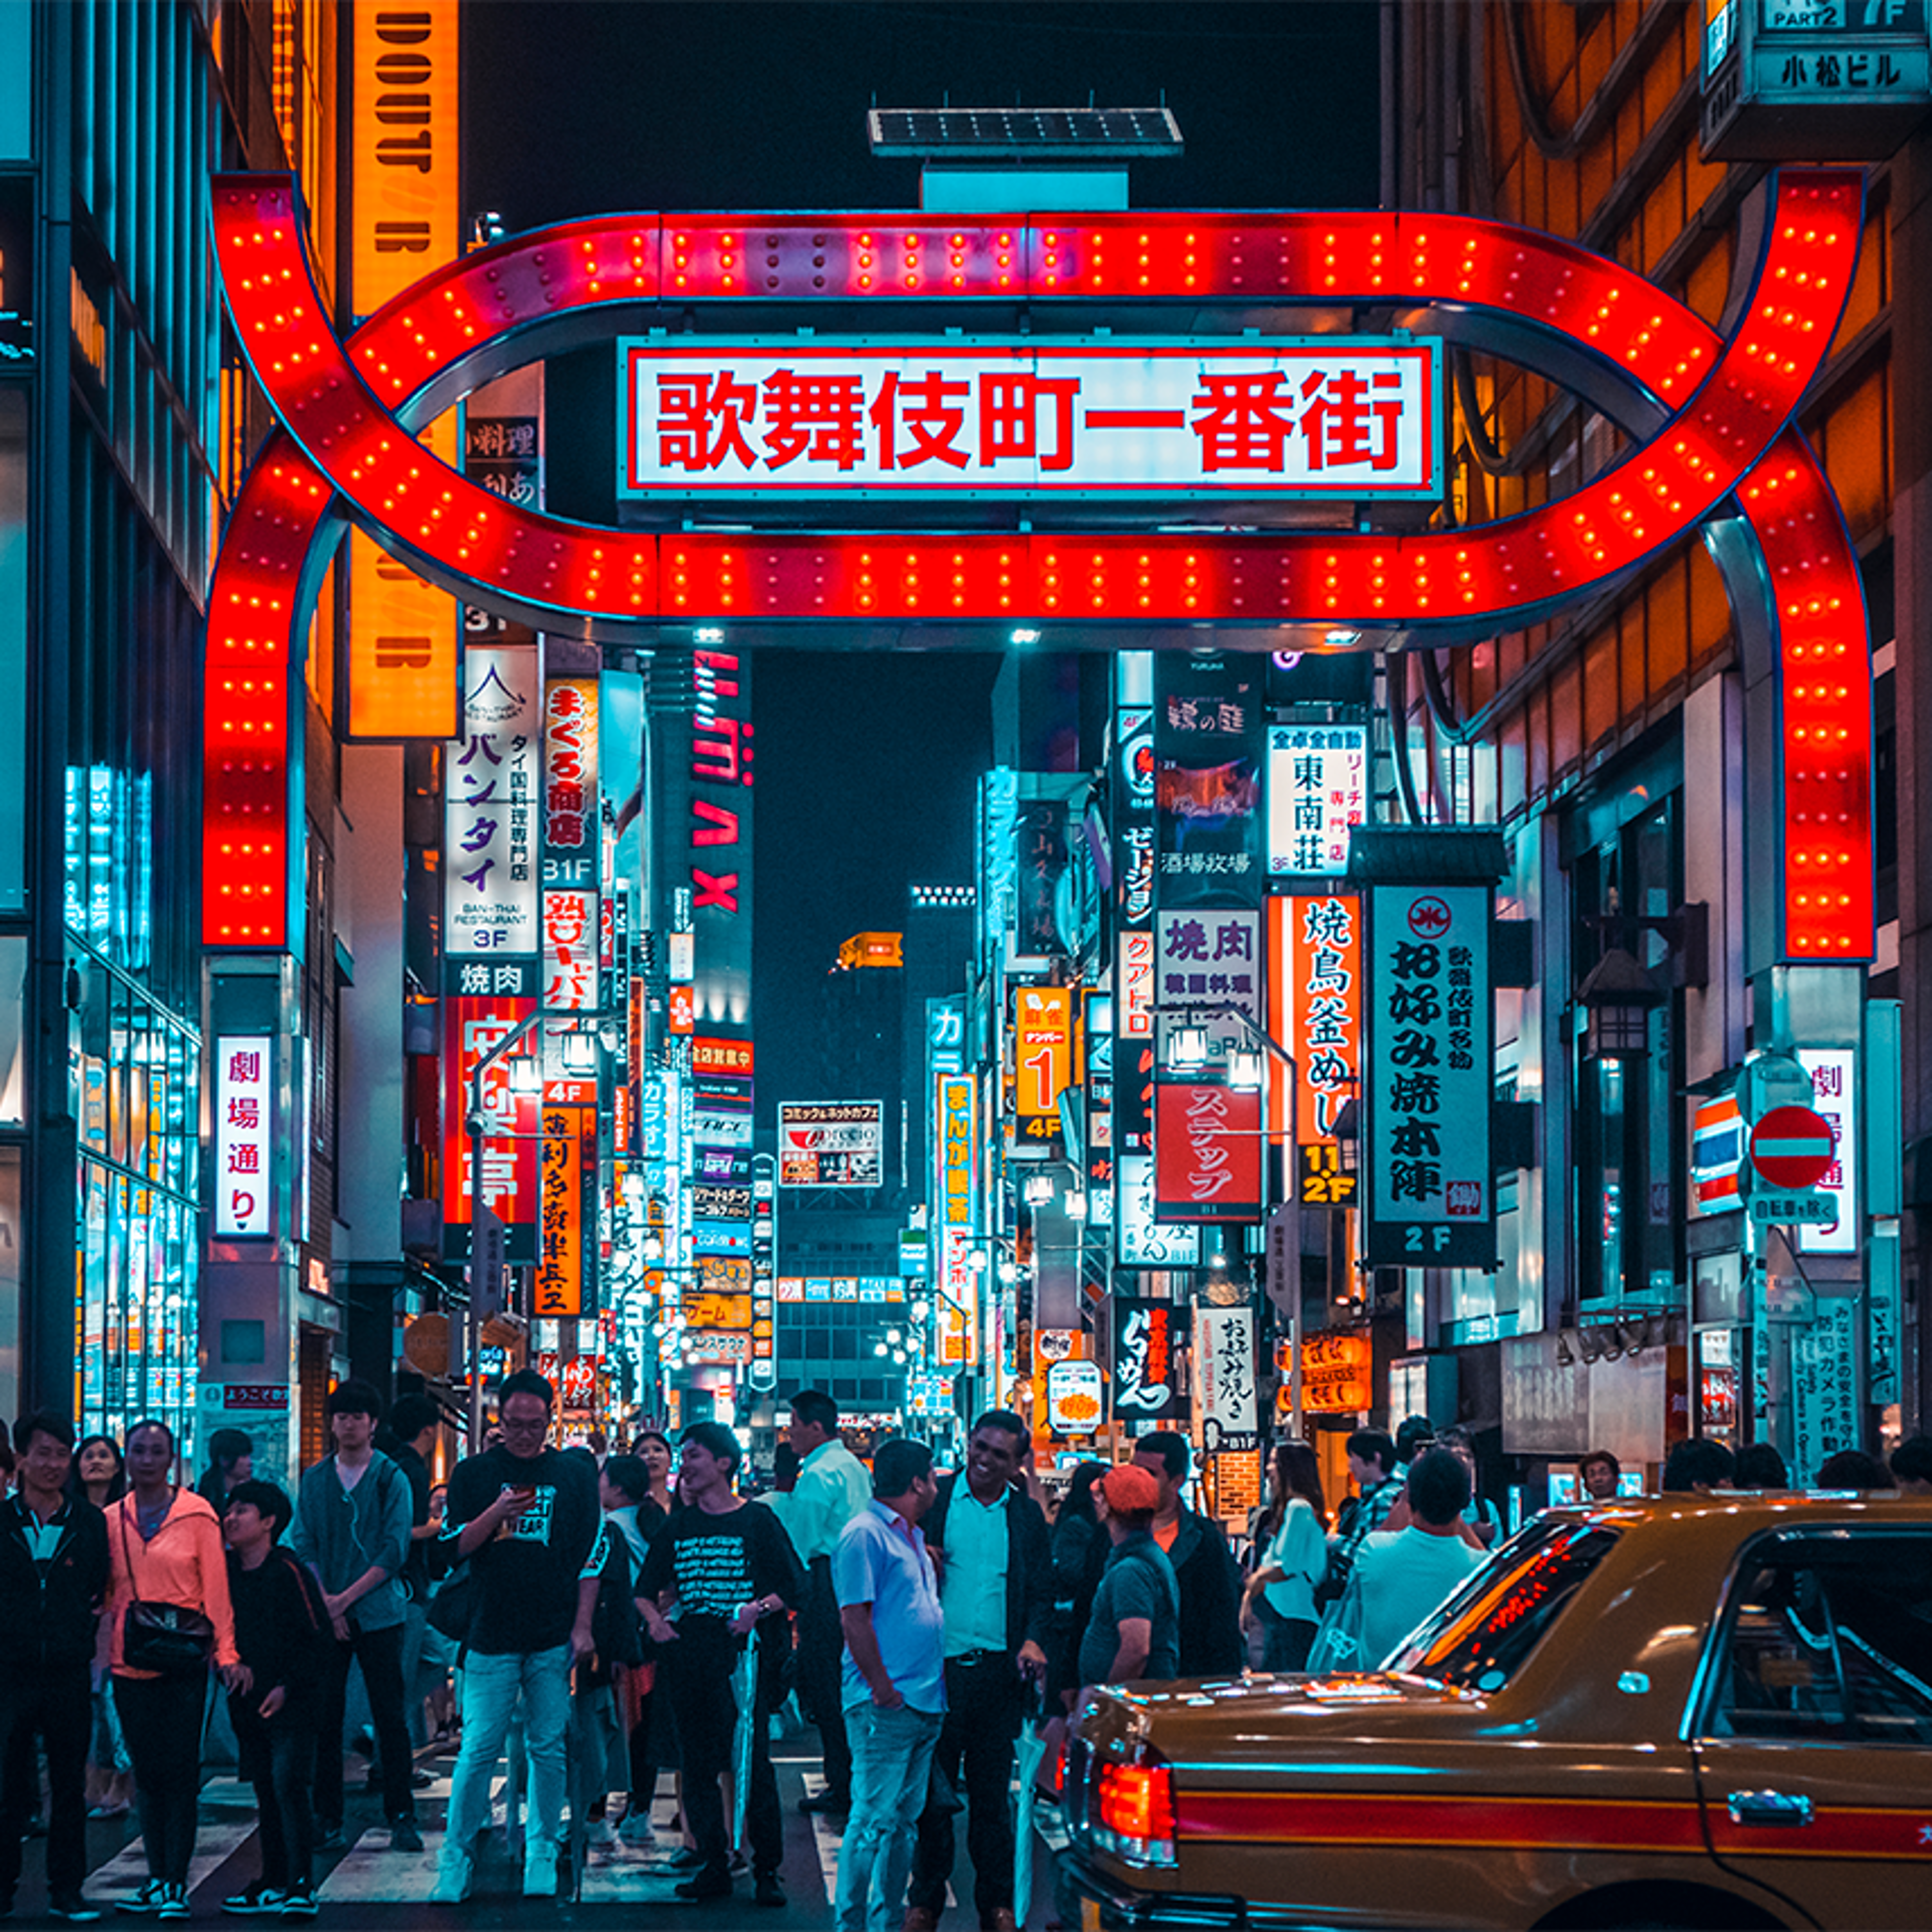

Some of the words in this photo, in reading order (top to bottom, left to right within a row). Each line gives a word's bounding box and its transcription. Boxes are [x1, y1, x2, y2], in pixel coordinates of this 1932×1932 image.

[1774, 6, 1837, 26] PART2
[1782, 54, 1901, 87] 小松ビル
[656, 369, 1405, 471] 歌舞伎町一番街
[457, 733, 502, 893] バンタイ
[1293, 754, 1325, 870] 東南荘
[473, 929, 508, 947] 3F
[460, 963, 522, 994] 焼肉
[1127, 936, 1151, 1034] クアトロ
[1302, 900, 1353, 1137] 焼鳥釜めし
[548, 1082, 581, 1102] 4F
[228, 1051, 261, 1220] 劇場通り
[1026, 1118, 1062, 1138] 4F
[1755, 1199, 1832, 1220] 自転車を除く
[1405, 1226, 1451, 1252] 2F
